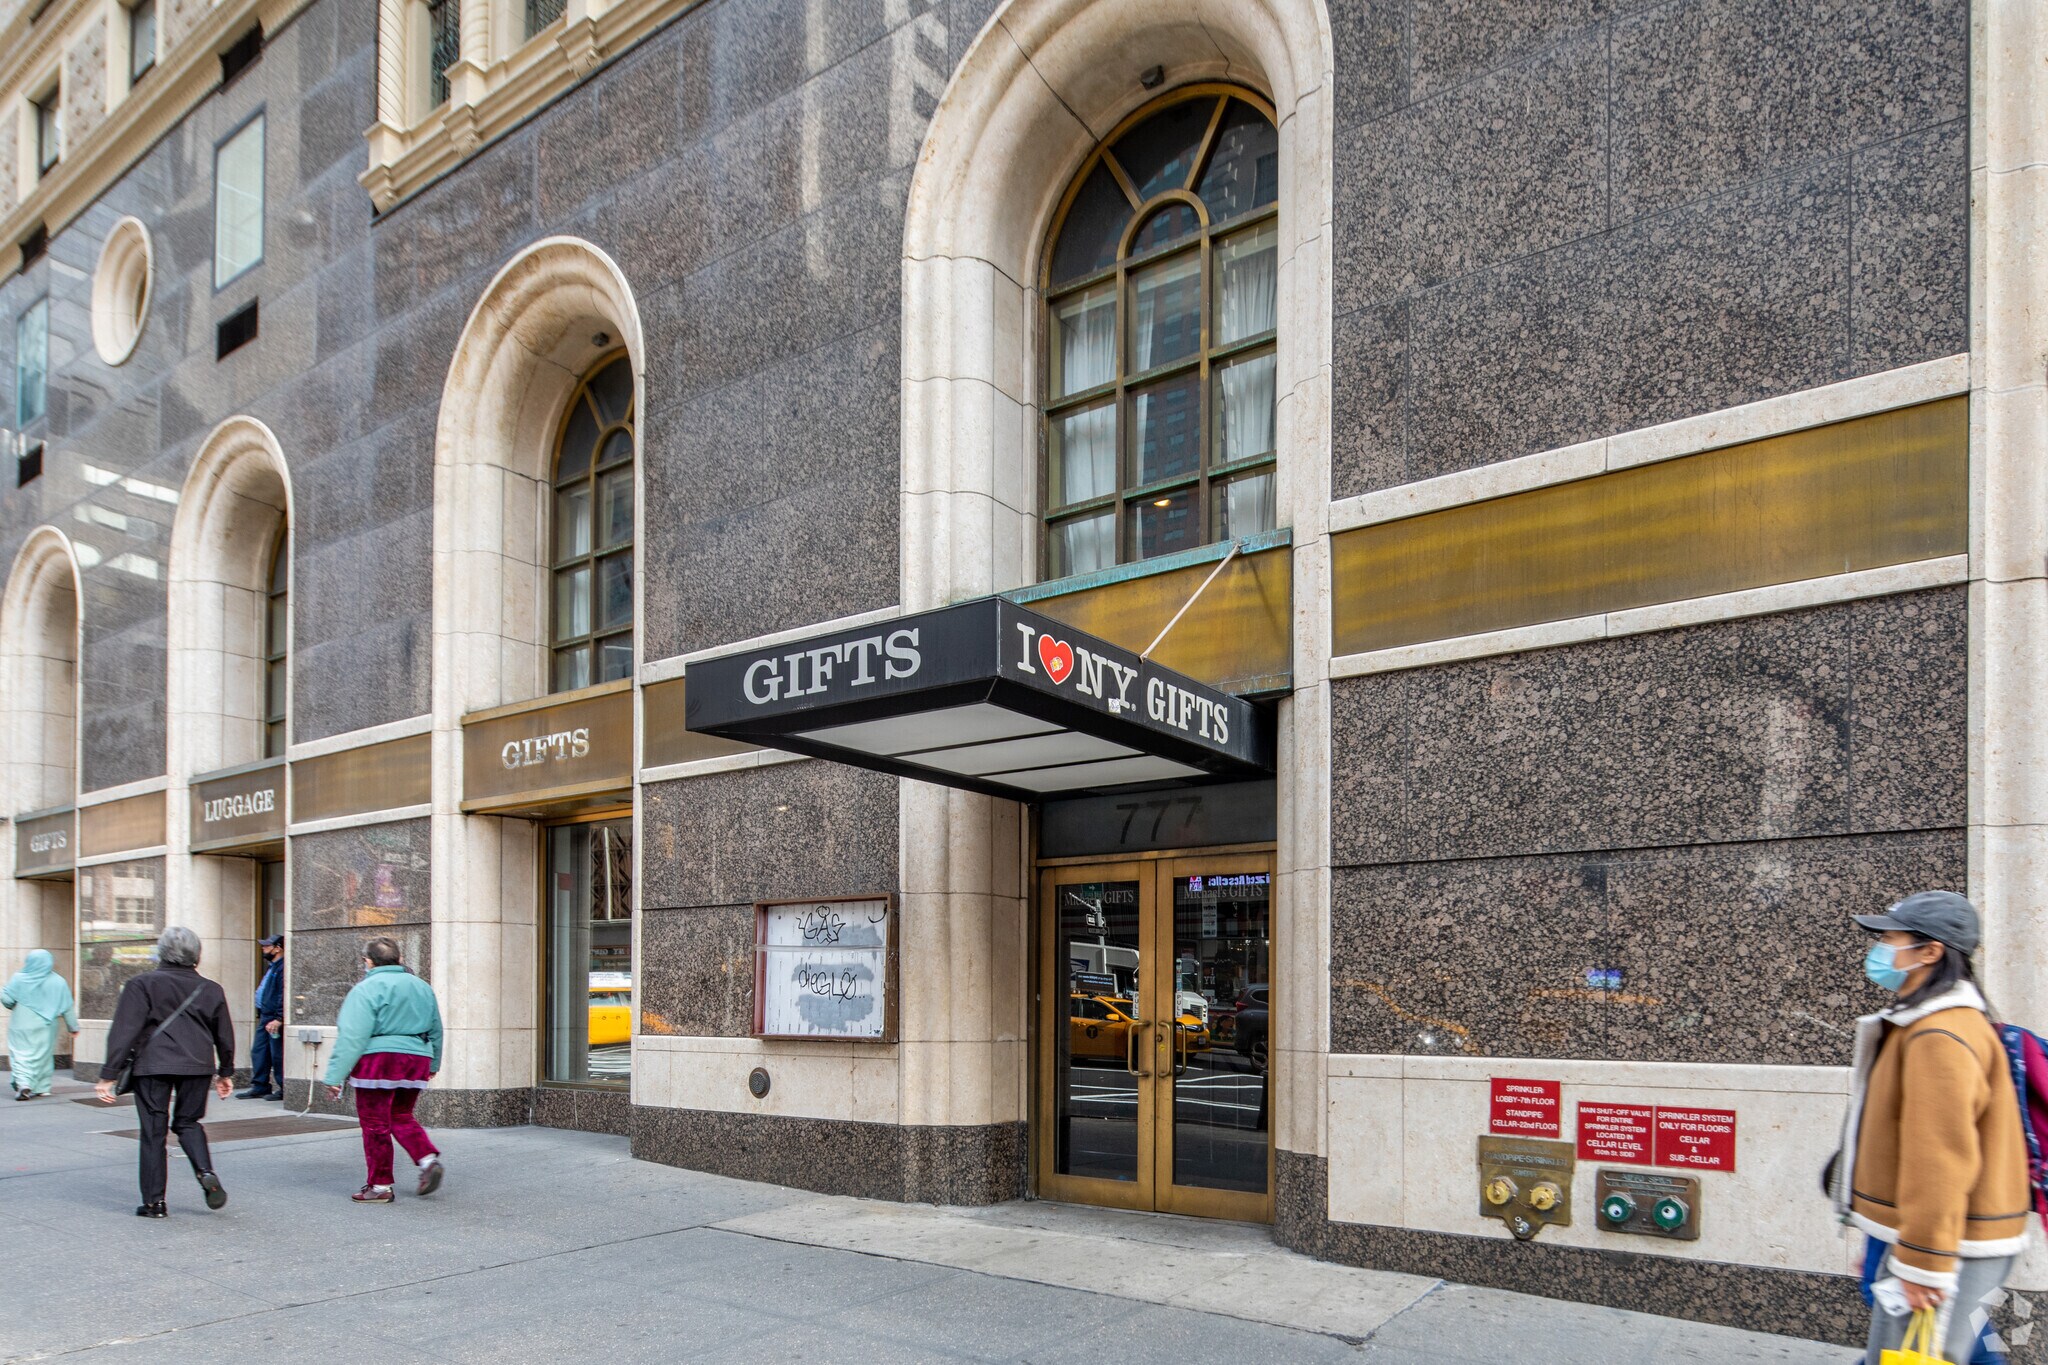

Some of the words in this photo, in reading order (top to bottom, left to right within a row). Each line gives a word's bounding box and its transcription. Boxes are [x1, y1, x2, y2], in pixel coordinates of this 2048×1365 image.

[743, 627, 922, 705] GIFTS
[1016, 622, 1036, 674] I
[1146, 677, 1229, 745] GIFTS
[501, 728, 590, 770] GIFTS
[204, 789, 275, 822] LUGGAGE
[1116, 796, 1202, 845] 777
[30, 829, 67, 852] GIFTS
[1104, 890, 1134, 904] GIFTS
[1229, 884, 1263, 898] GIFTS
[1495, 1095, 1531, 1104] LOBBY-7th
[1596, 1107, 1629, 1115] SHUT-OFF
[1657, 1111, 1700, 1121] SPRINKLER
[1701, 1114, 1734, 1123] SYSTEM
[1492, 1119, 1535, 1129] CELLAR-22nd
[1535, 1122, 1558, 1130] FLOOR
[1584, 1123, 1619, 1131] SPRINKLER
[1620, 1125, 1646, 1133] SYSTEM
[1659, 1121, 1680, 1130] ONLY
[1680, 1122, 1697, 1131] FOR
[1697, 1124, 1732, 1133] FLOORS:
[1596, 1132, 1626, 1140] LOCATED
[1679, 1135, 1710, 1145] CELLAR
[1586, 1139, 1617, 1148] CELLAR
[1617, 1141, 1644, 1151] LEVEL
[1669, 1154, 1720, 1164] SUB-CELLAR
